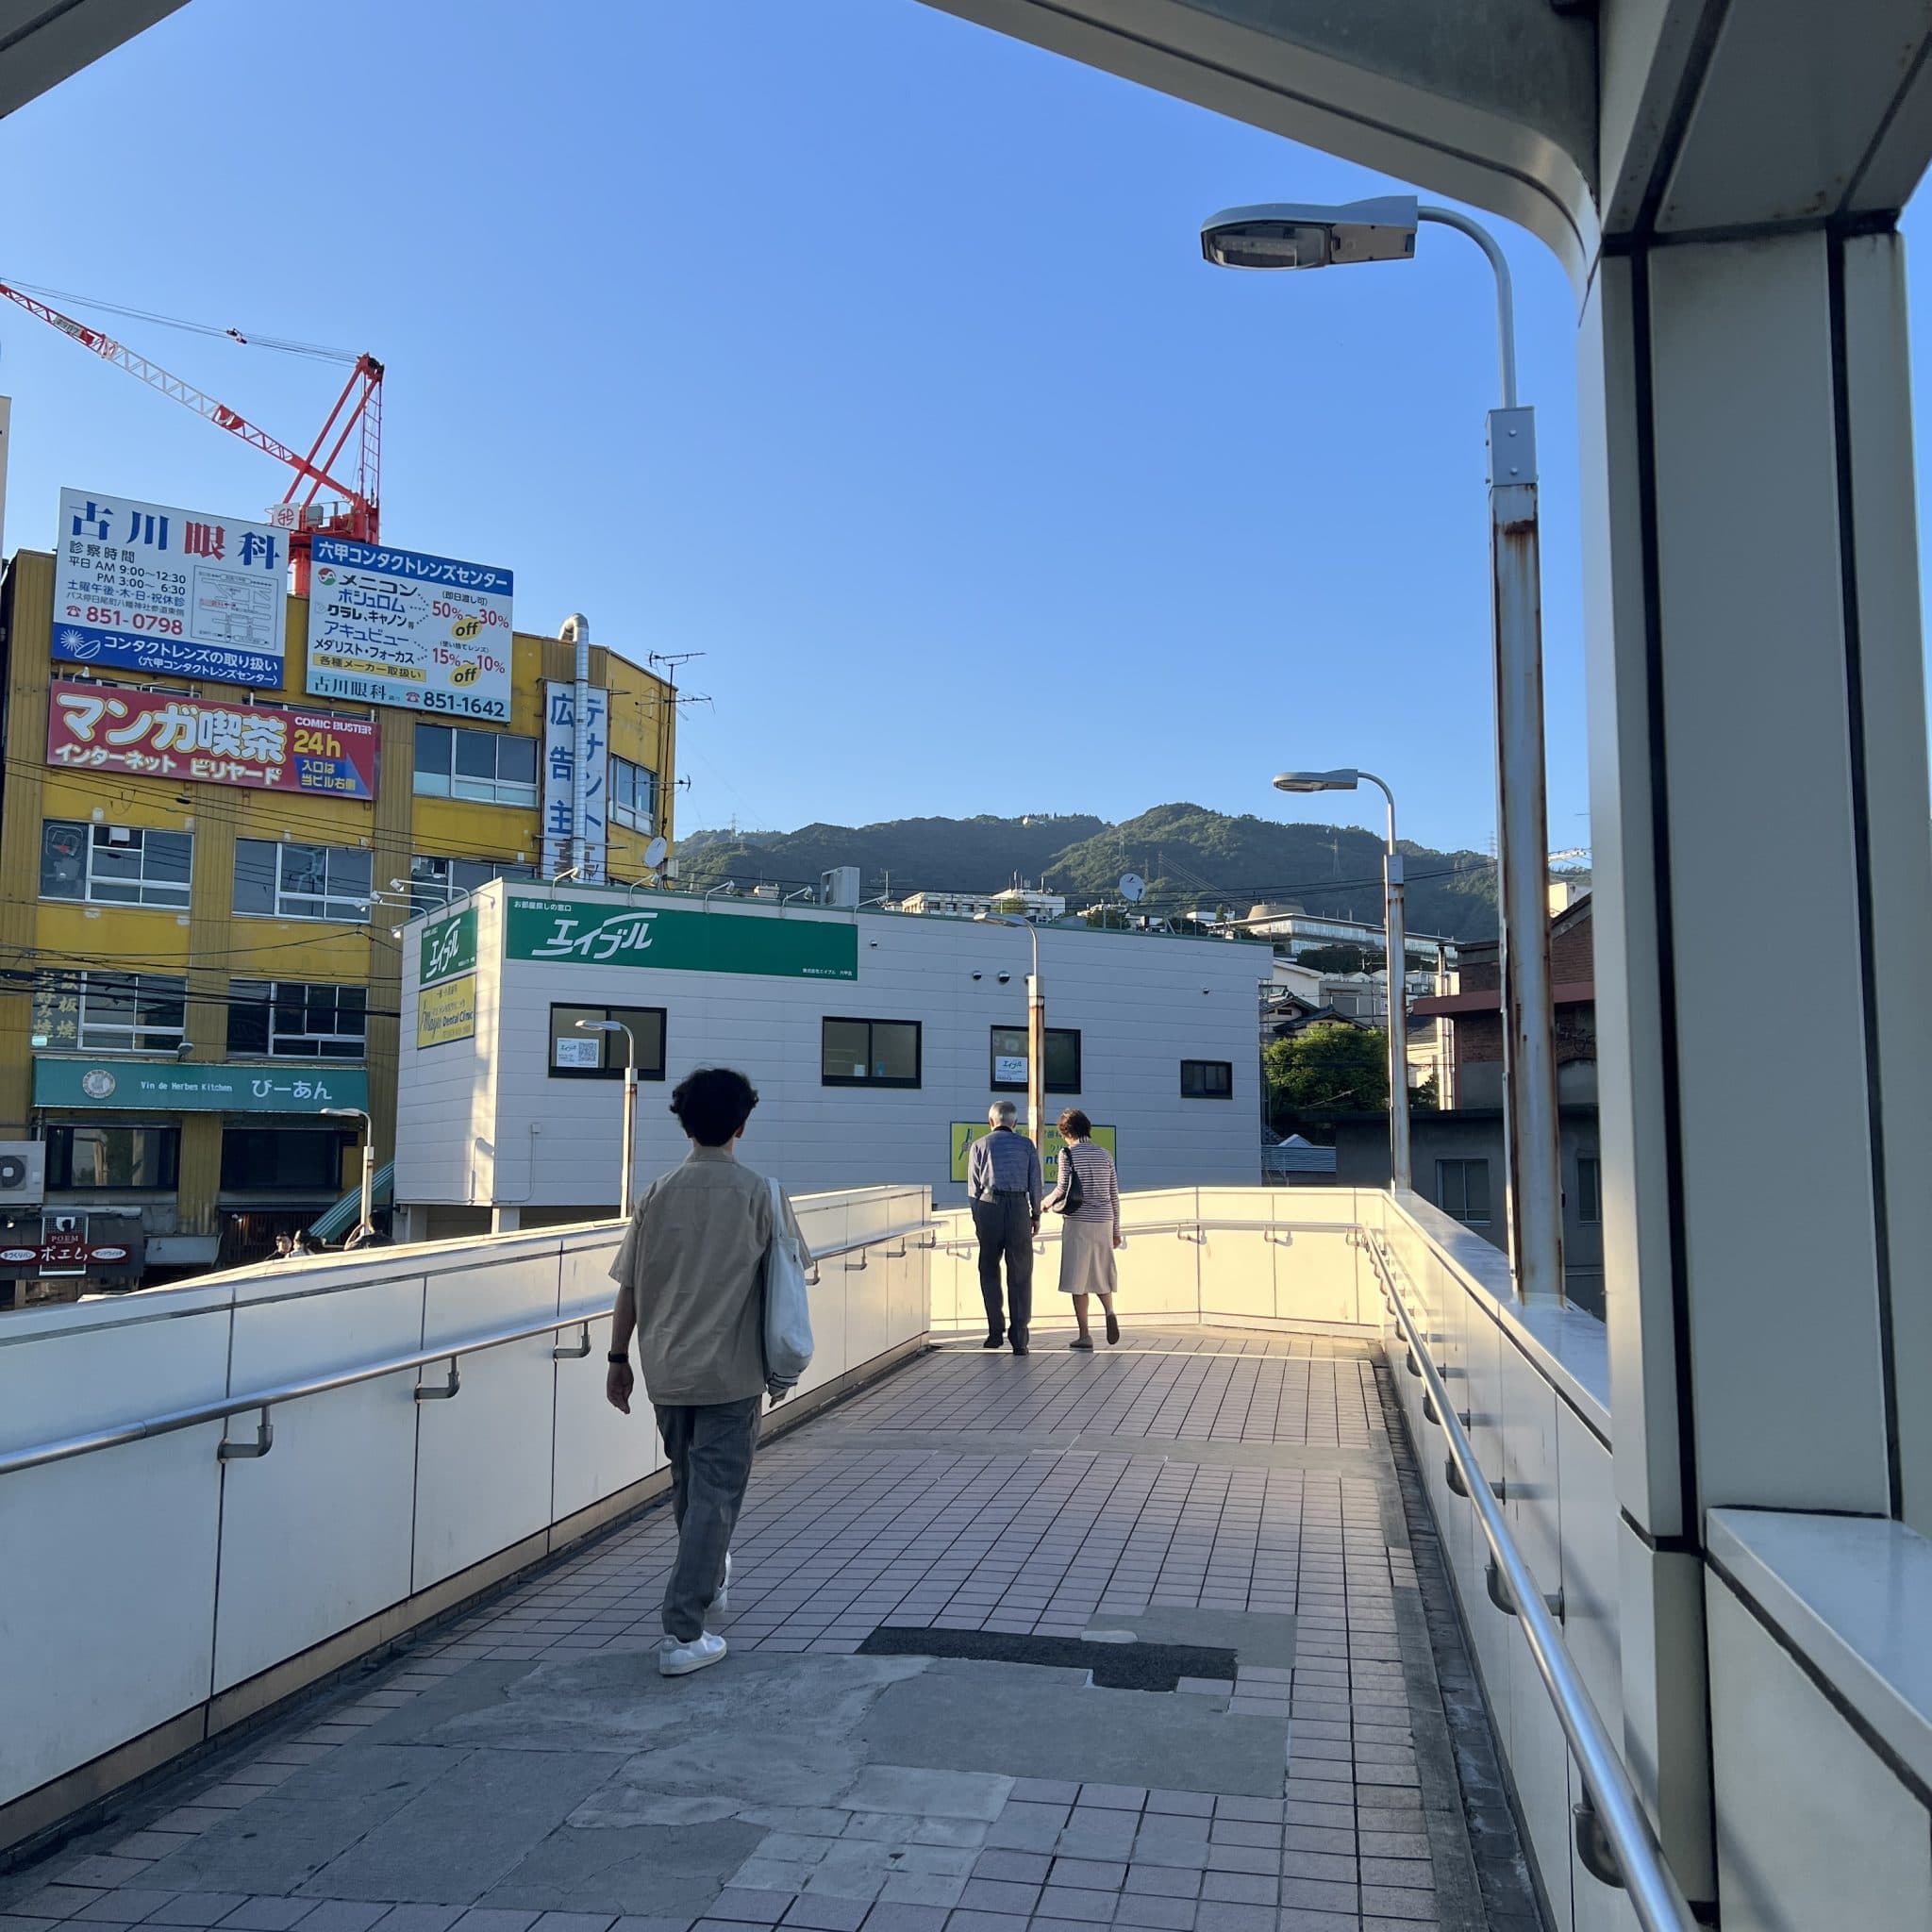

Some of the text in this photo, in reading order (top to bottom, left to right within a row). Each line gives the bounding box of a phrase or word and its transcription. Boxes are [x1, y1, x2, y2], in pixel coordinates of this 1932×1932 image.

[69, 501, 280, 570] 古川眼科
[68, 556, 91, 569] 平日
[95, 560, 115, 573] AM
[69, 541, 135, 564] 診察時間
[319, 541, 508, 588] 六甲コンタクトレンズセンター
[97, 573, 115, 584] PM
[338, 575, 418, 597] メニコン
[338, 589, 406, 613] ボシュロム
[86, 606, 183, 635] 851-0798
[324, 620, 409, 646] アキュビュー
[455, 621, 478, 637] off
[104, 636, 278, 672] コンタクトレンズの取り扱い
[313, 638, 415, 664] メダリスト・フォーカス
[320, 656, 422, 679] 各種メーカー取扱い
[454, 667, 477, 683] off
[314, 675, 387, 701] 古川眼科
[424, 691, 506, 718] 851-1642
[57, 693, 287, 764] マンガ喫茶
[294, 716, 372, 736] COMIC BUSTER
[55, 743, 283, 786] インターネット ビリヤード
[302, 759, 335, 774] 入口は
[425, 917, 461, 979] エイブル
[531, 912, 658, 959] エイブル
[252, 1079, 333, 1100] びーあん
[41, 1245, 89, 1261] ポエム
